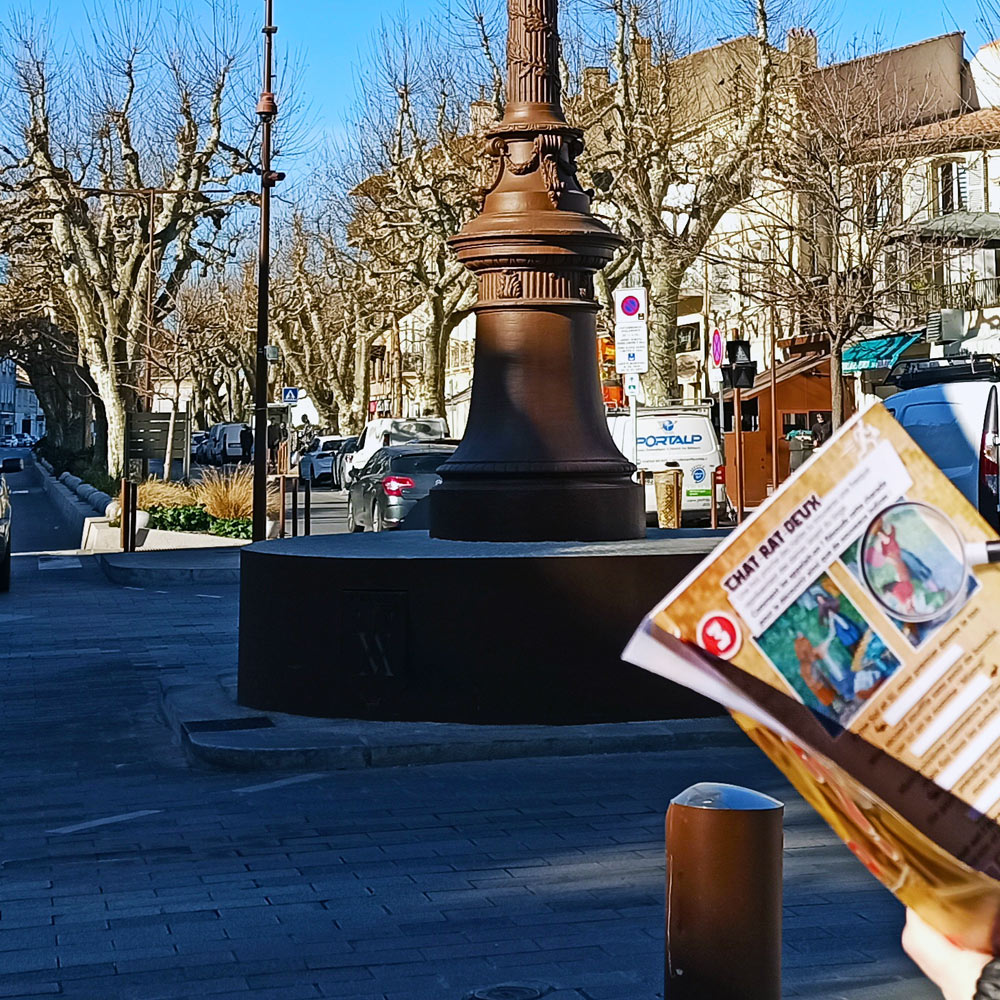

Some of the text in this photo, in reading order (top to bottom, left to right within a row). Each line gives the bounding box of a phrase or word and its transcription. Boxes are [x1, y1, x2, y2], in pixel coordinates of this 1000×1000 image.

[637, 434, 702, 447] PORTALP
[723, 494, 823, 592] CHAT RAT DEUX
[705, 618, 732, 652] 3
